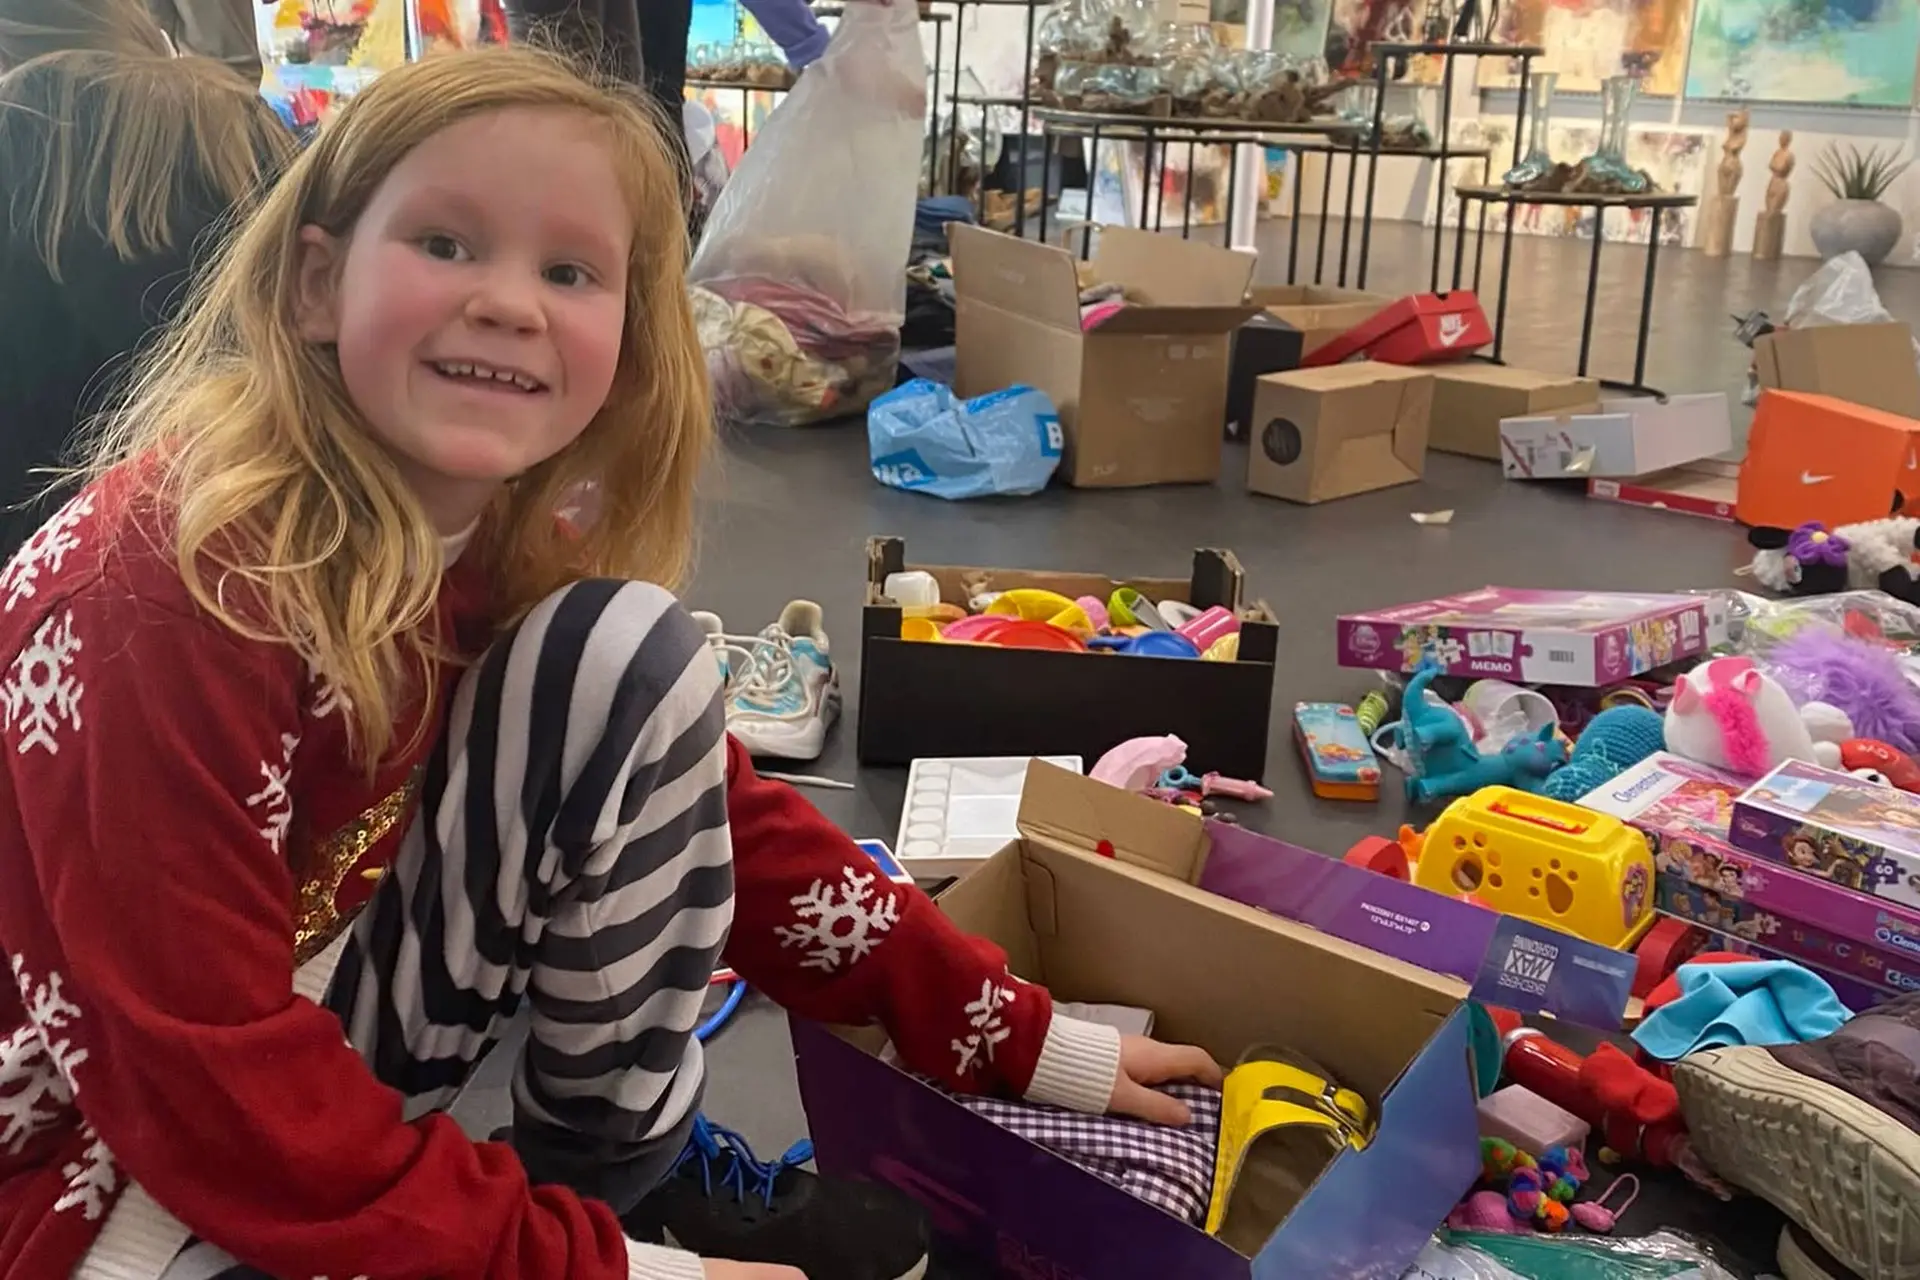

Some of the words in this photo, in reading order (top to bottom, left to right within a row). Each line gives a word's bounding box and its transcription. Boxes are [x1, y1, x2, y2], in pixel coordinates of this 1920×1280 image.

[1471, 660, 1513, 673] MEMO
[1504, 949, 1554, 982] MAX
[1497, 972, 1547, 997] SKECHERS
